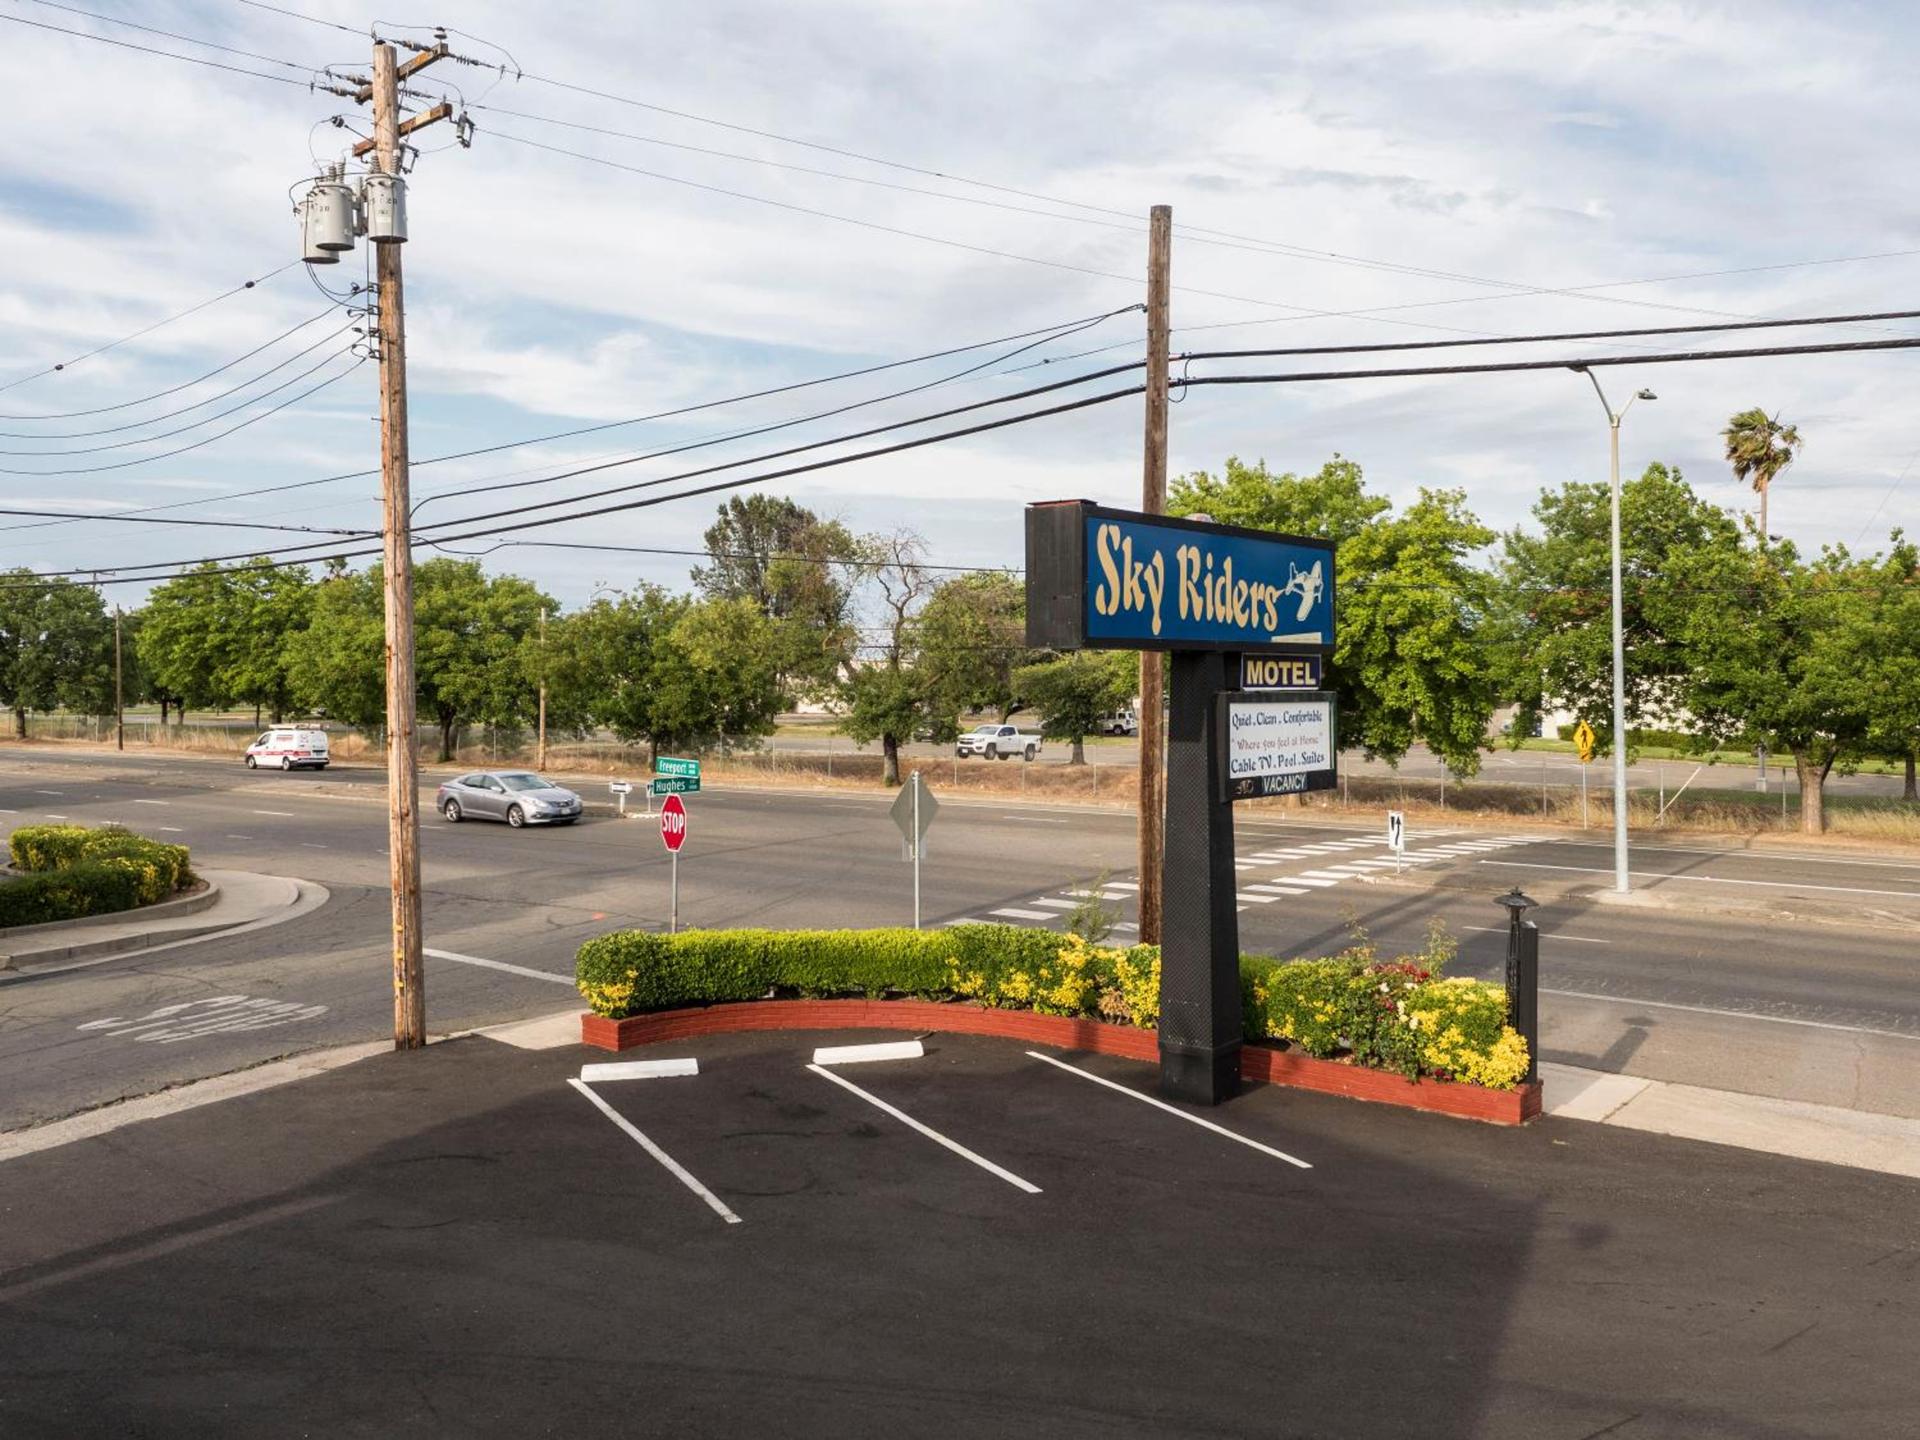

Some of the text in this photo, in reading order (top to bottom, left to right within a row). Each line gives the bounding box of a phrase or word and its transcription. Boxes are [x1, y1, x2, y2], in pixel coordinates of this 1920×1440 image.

[1095, 524, 1279, 636] Sky Riders
[1246, 660, 1317, 686] MOTEL
[659, 760, 687, 775] Freeport
[1231, 758, 1256, 774] Cable
[1278, 753, 1296, 768] Pool
[656, 780, 686, 793] Hughes
[1263, 774, 1307, 793] VACANCY
[662, 811, 685, 834] STOP
[76, 994, 330, 1044] STOP
